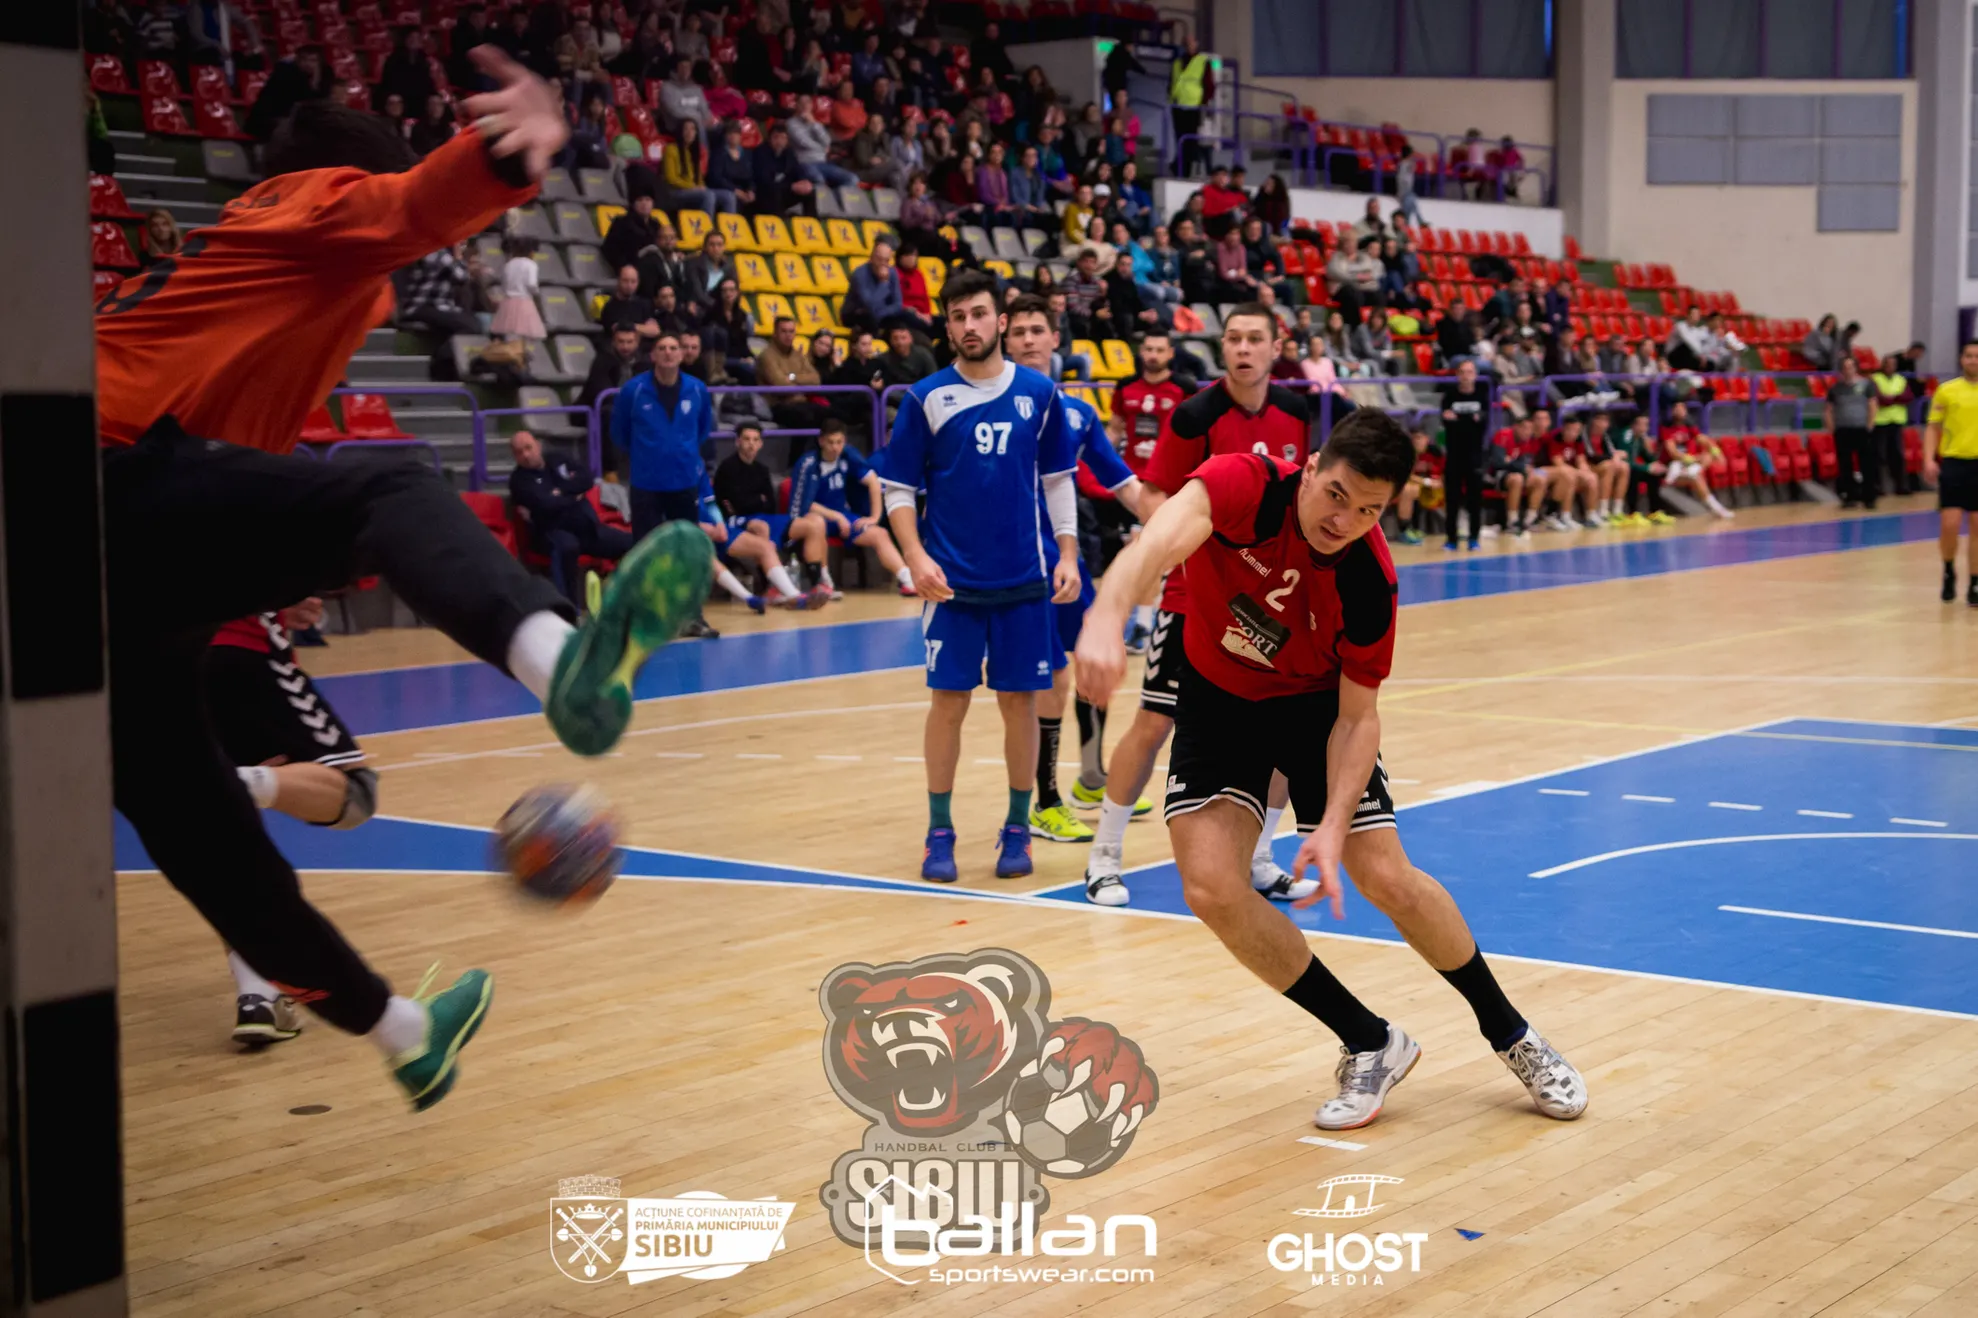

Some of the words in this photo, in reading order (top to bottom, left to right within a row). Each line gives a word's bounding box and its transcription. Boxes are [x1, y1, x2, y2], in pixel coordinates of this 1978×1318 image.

[974, 421, 1013, 455] 97
[1239, 548, 1272, 578] hummel
[1264, 568, 1301, 613] 2
[1356, 797, 1382, 812] mmel
